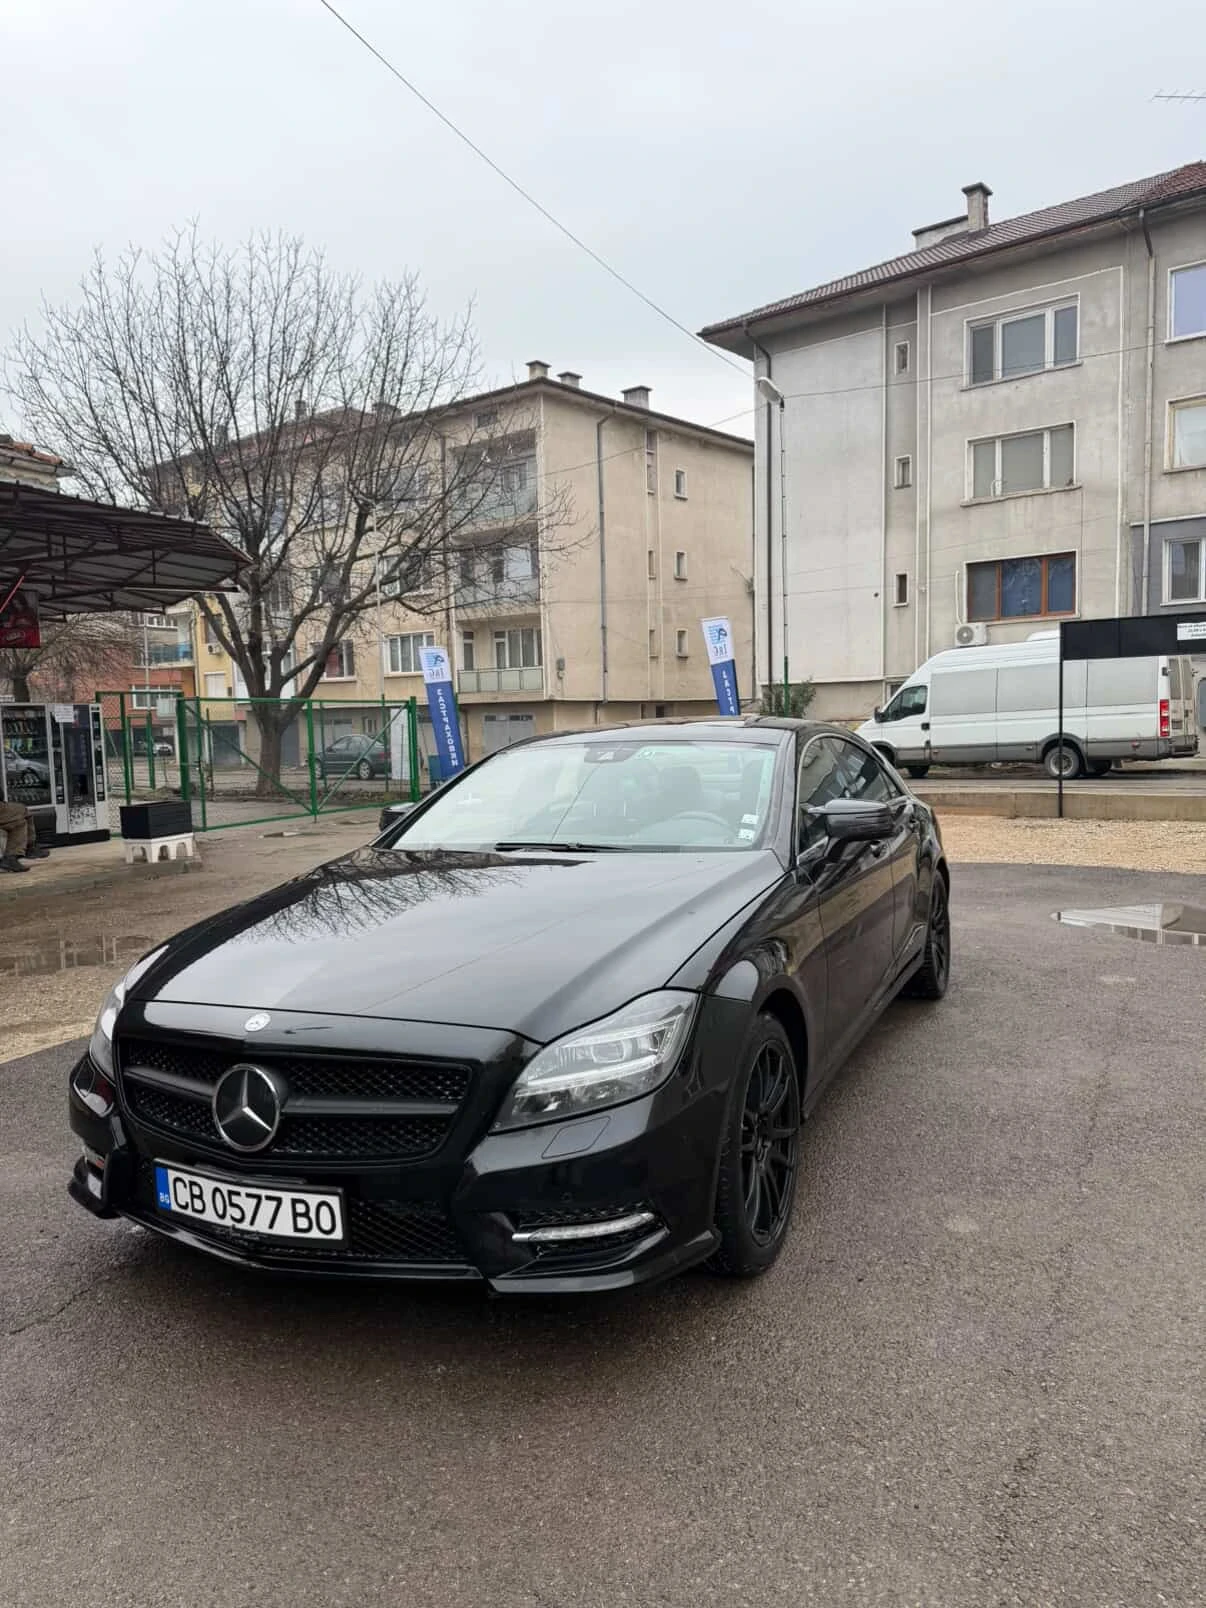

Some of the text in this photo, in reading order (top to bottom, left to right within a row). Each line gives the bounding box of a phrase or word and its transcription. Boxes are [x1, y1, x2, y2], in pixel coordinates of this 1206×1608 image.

[159, 1192, 170, 1204] BG
[173, 1176, 337, 1235] CB 0577 BO
